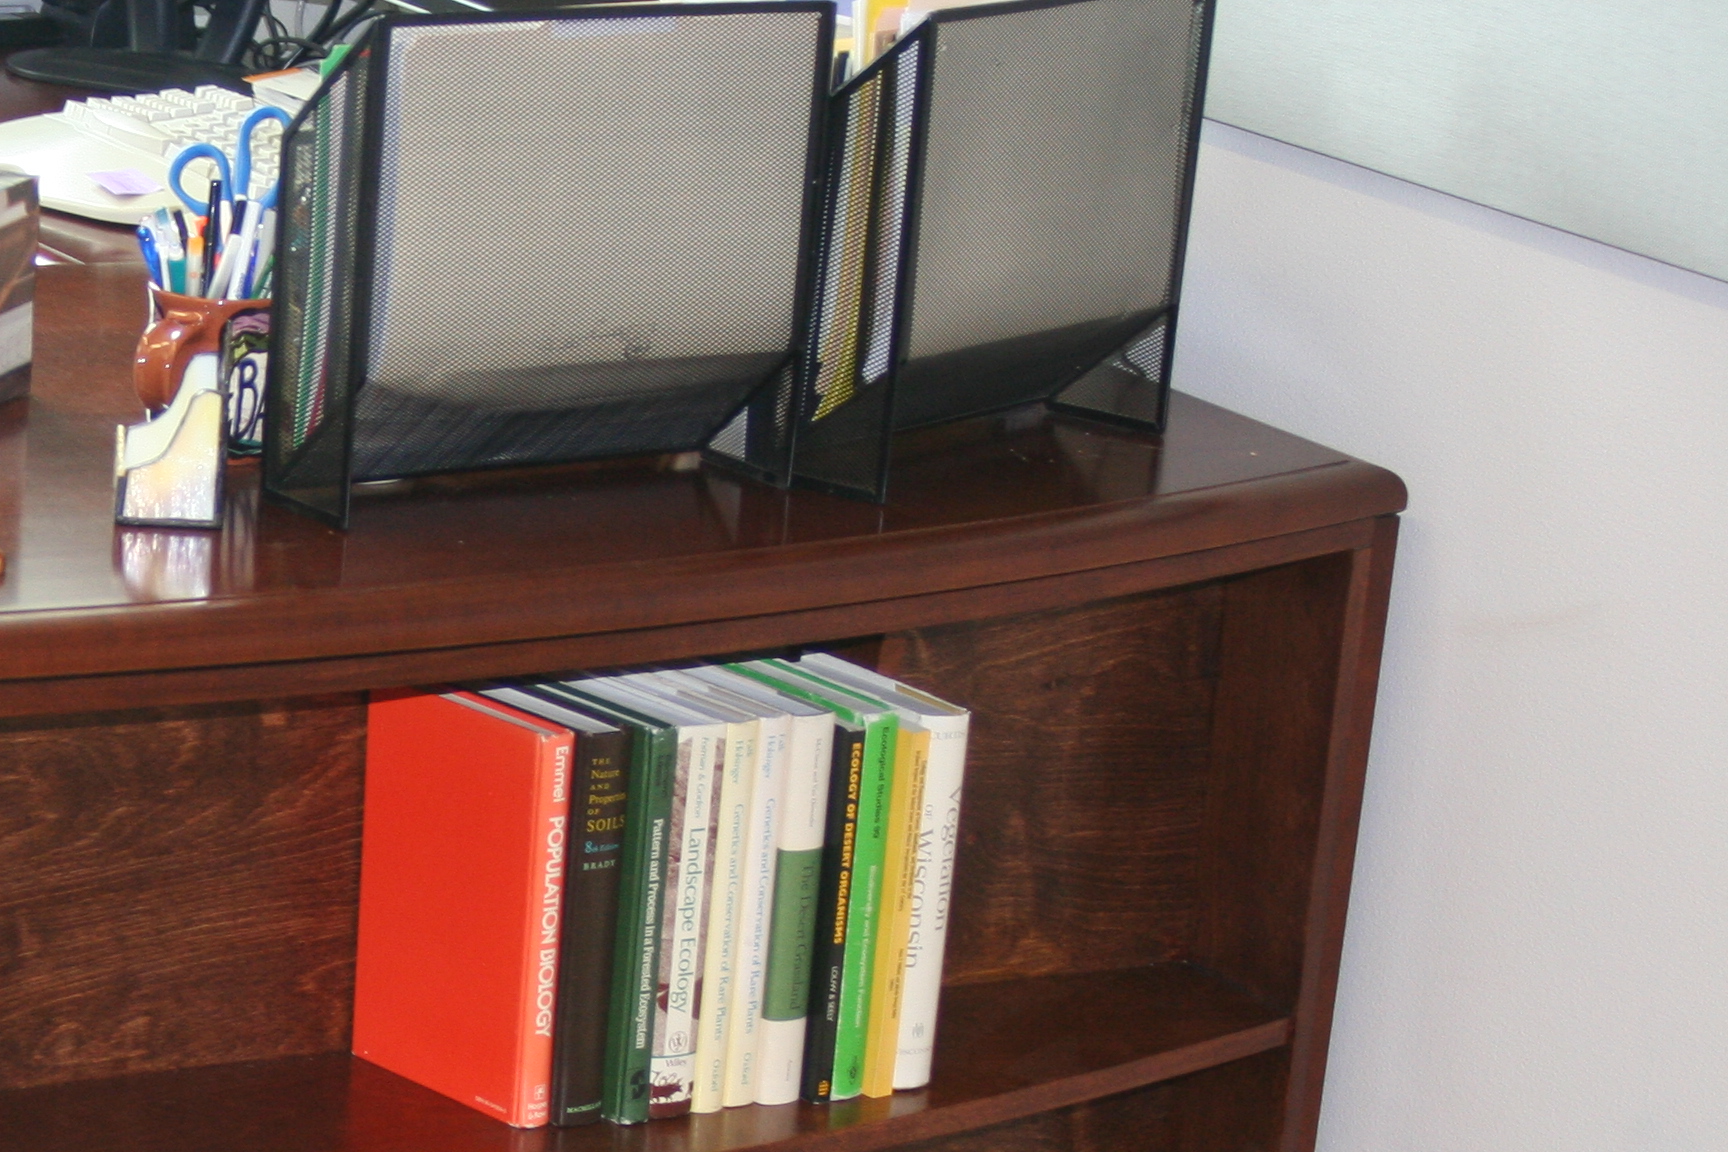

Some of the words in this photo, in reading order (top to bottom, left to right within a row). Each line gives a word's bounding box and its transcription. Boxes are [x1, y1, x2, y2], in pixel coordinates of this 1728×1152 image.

[553, 746, 571, 802] Emmel
[591, 769, 621, 779] Nature
[848, 742, 863, 801] ECOLOGY
[875, 727, 890, 780] Ecological
[586, 815, 626, 832] SOILS
[763, 798, 777, 849] Genetics
[846, 803, 858, 820] OF
[873, 784, 887, 822] Studies
[651, 818, 666, 858] Pattern
[731, 803, 745, 855] Genetics
[841, 823, 855, 867] DESERT
[541, 816, 566, 944] POPULATION
[582, 860, 616, 871] BRADY
[649, 860, 661, 881] and
[678, 827, 707, 931] Landscape
[728, 858, 739, 879] and
[760, 852, 771, 873] and
[801, 865, 815, 892] The
[645, 883, 659, 925] Process
[720, 881, 738, 957] Conservation
[753, 876, 770, 951] Conservation
[797, 896, 813, 940] Desert
[833, 871, 850, 945] ORGANISMS
[904, 829, 935, 969] Wisconsin
[640, 947, 655, 991] Forested
[671, 937, 697, 1014] Ecology
[719, 961, 731, 972] of
[751, 955, 762, 967] of
[789, 943, 808, 1011] Grassland
[535, 950, 555, 1037] BIOLOGY
[718, 976, 730, 1003] Rare
[748, 970, 761, 997] Rare
[635, 993, 651, 1049] Ecosystem
[713, 1006, 728, 1041] Plants
[744, 1001, 759, 1035] Plants
